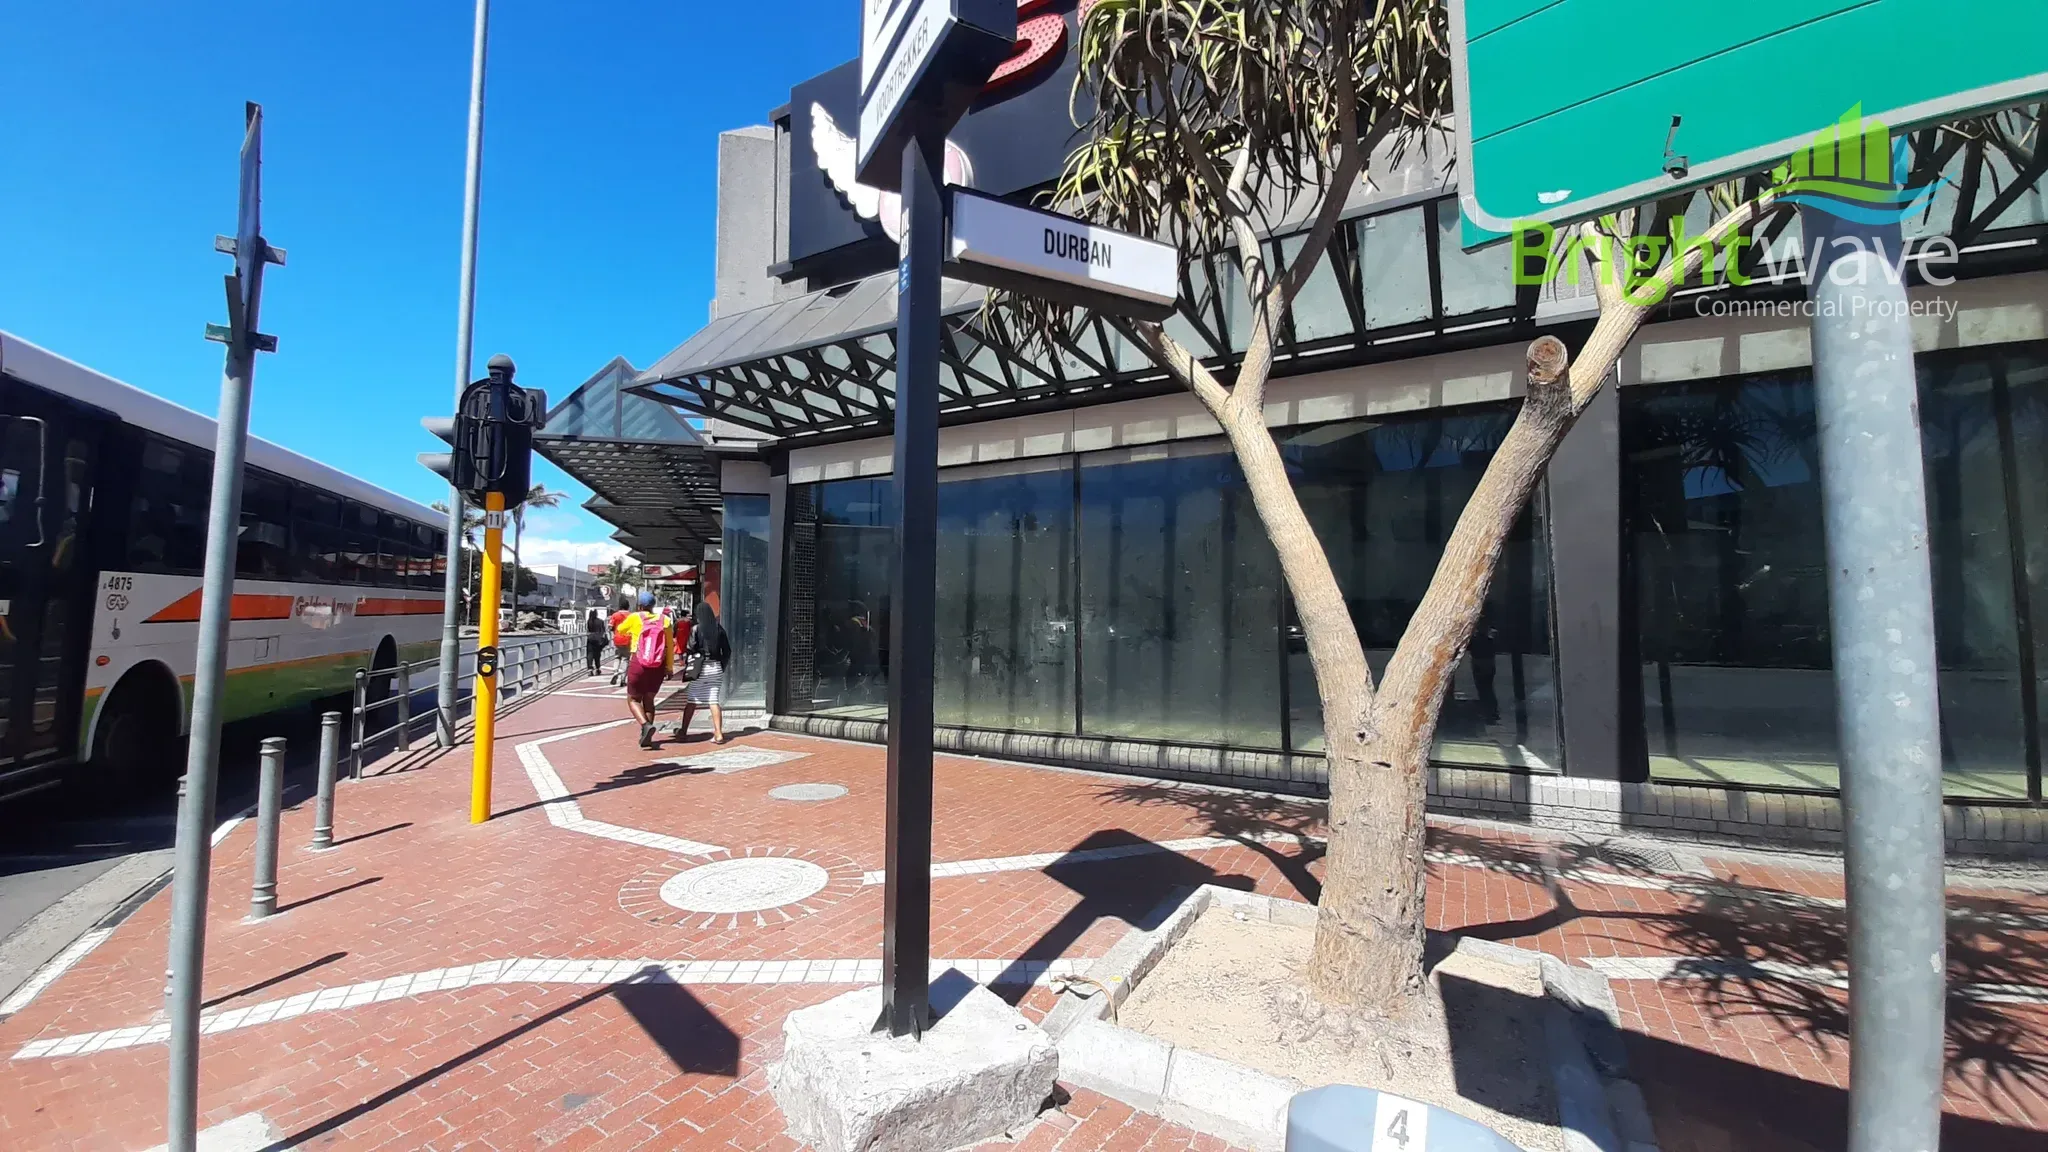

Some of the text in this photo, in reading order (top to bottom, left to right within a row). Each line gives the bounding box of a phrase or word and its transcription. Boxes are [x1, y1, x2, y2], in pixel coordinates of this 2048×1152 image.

[876, 16, 928, 125] VOORTREKKER
[1044, 228, 1111, 269] DURBAN
[489, 513, 500, 526] 11
[108, 577, 132, 590] 4875
[1387, 1109, 1410, 1150] 4
